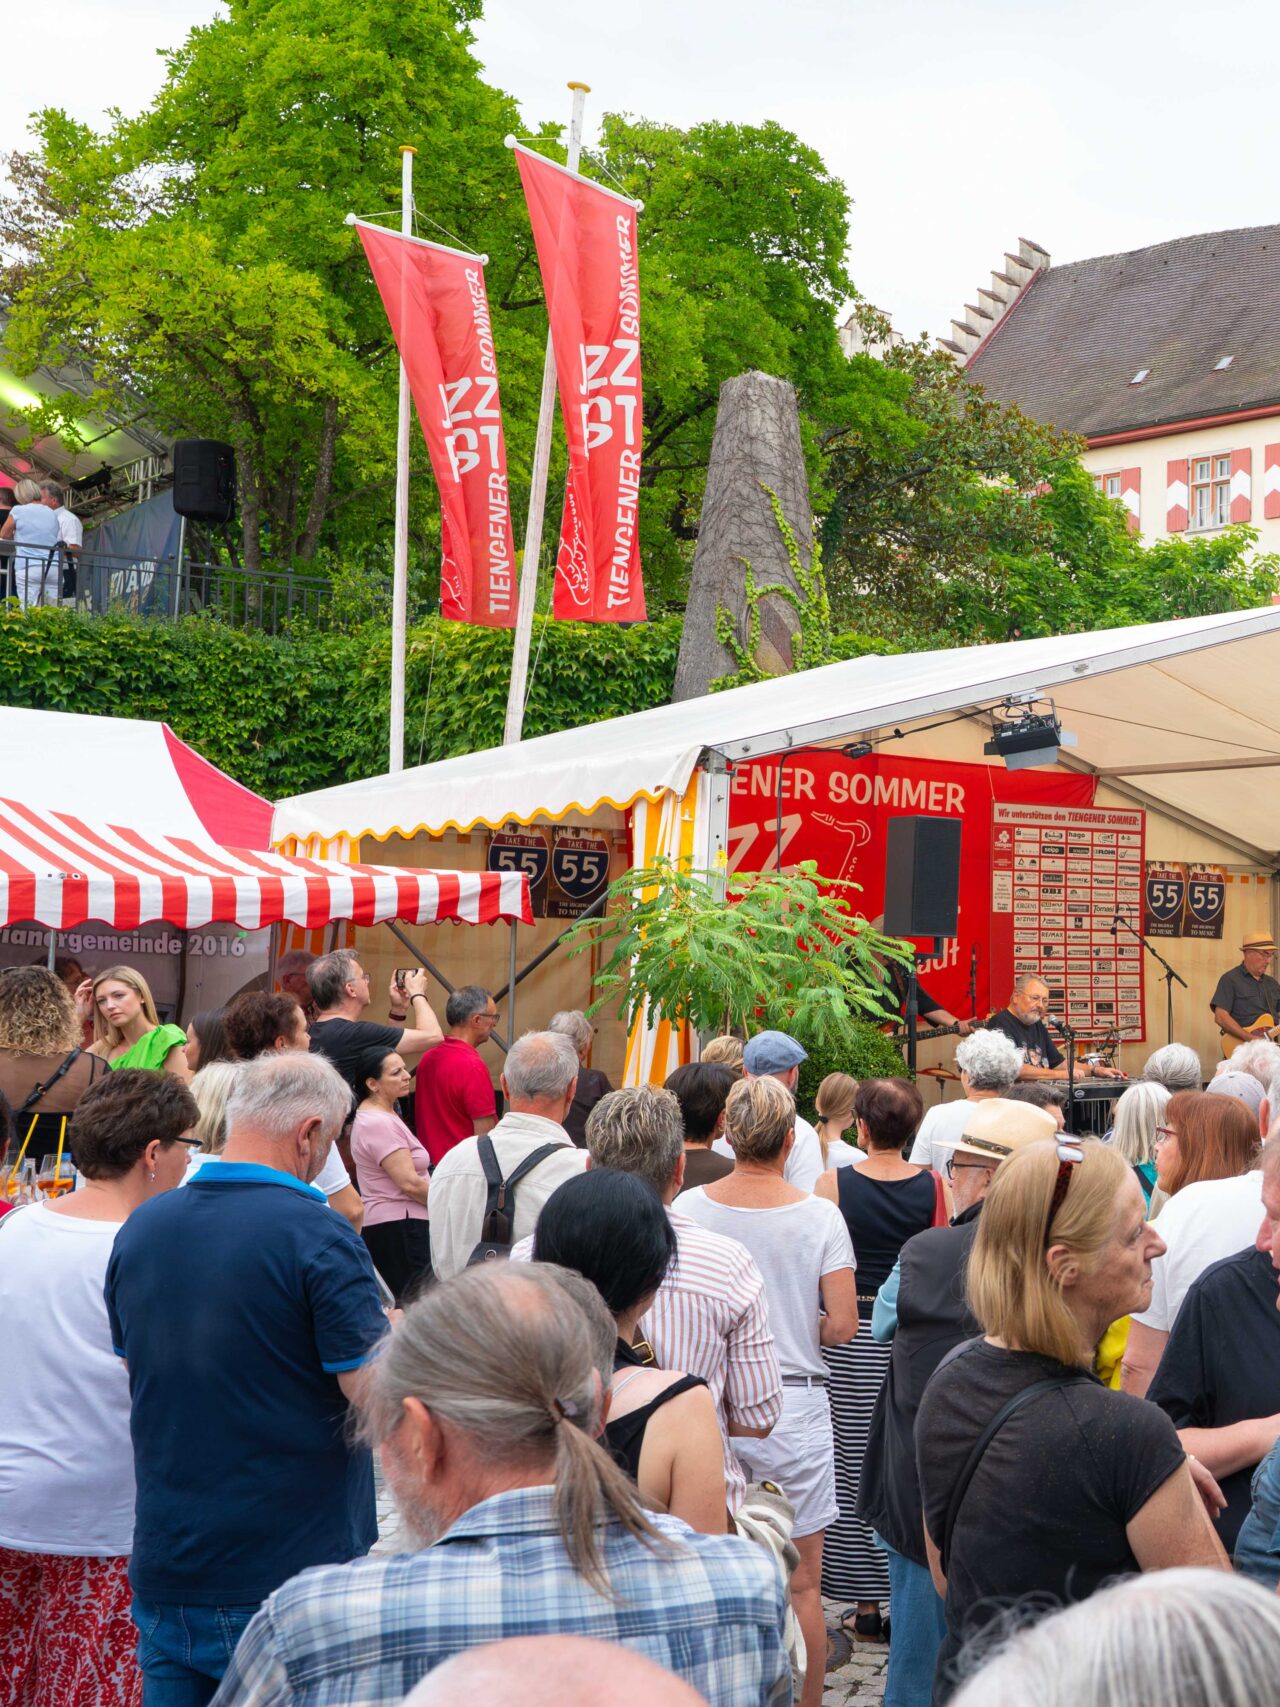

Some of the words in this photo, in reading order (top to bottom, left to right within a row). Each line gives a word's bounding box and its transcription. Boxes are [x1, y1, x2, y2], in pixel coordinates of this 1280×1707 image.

[615, 215, 639, 337] SOMMER
[465, 268, 496, 374] SOMMER
[602, 449, 641, 608] TIENGENER
[488, 473, 511, 614] TIENGENER
[731, 764, 816, 800] ENER
[828, 771, 965, 813] SOMMER
[998, 808, 1010, 818] Wir
[1011, 811, 1052, 820] unterstützen
[1053, 811, 1066, 821] den
[1068, 812, 1106, 824] TIENGENER
[505, 837, 520, 845] TAKE
[524, 837, 536, 846] THE
[567, 840, 583, 849] TAKE
[586, 841, 598, 850] THE
[498, 851, 538, 880] 55
[560, 854, 599, 884] 55
[1151, 884, 1178, 908] 55
[1193, 886, 1219, 910] 55
[0, 928, 182, 955] ianergemeinde
[189, 934, 246, 957] 2016
